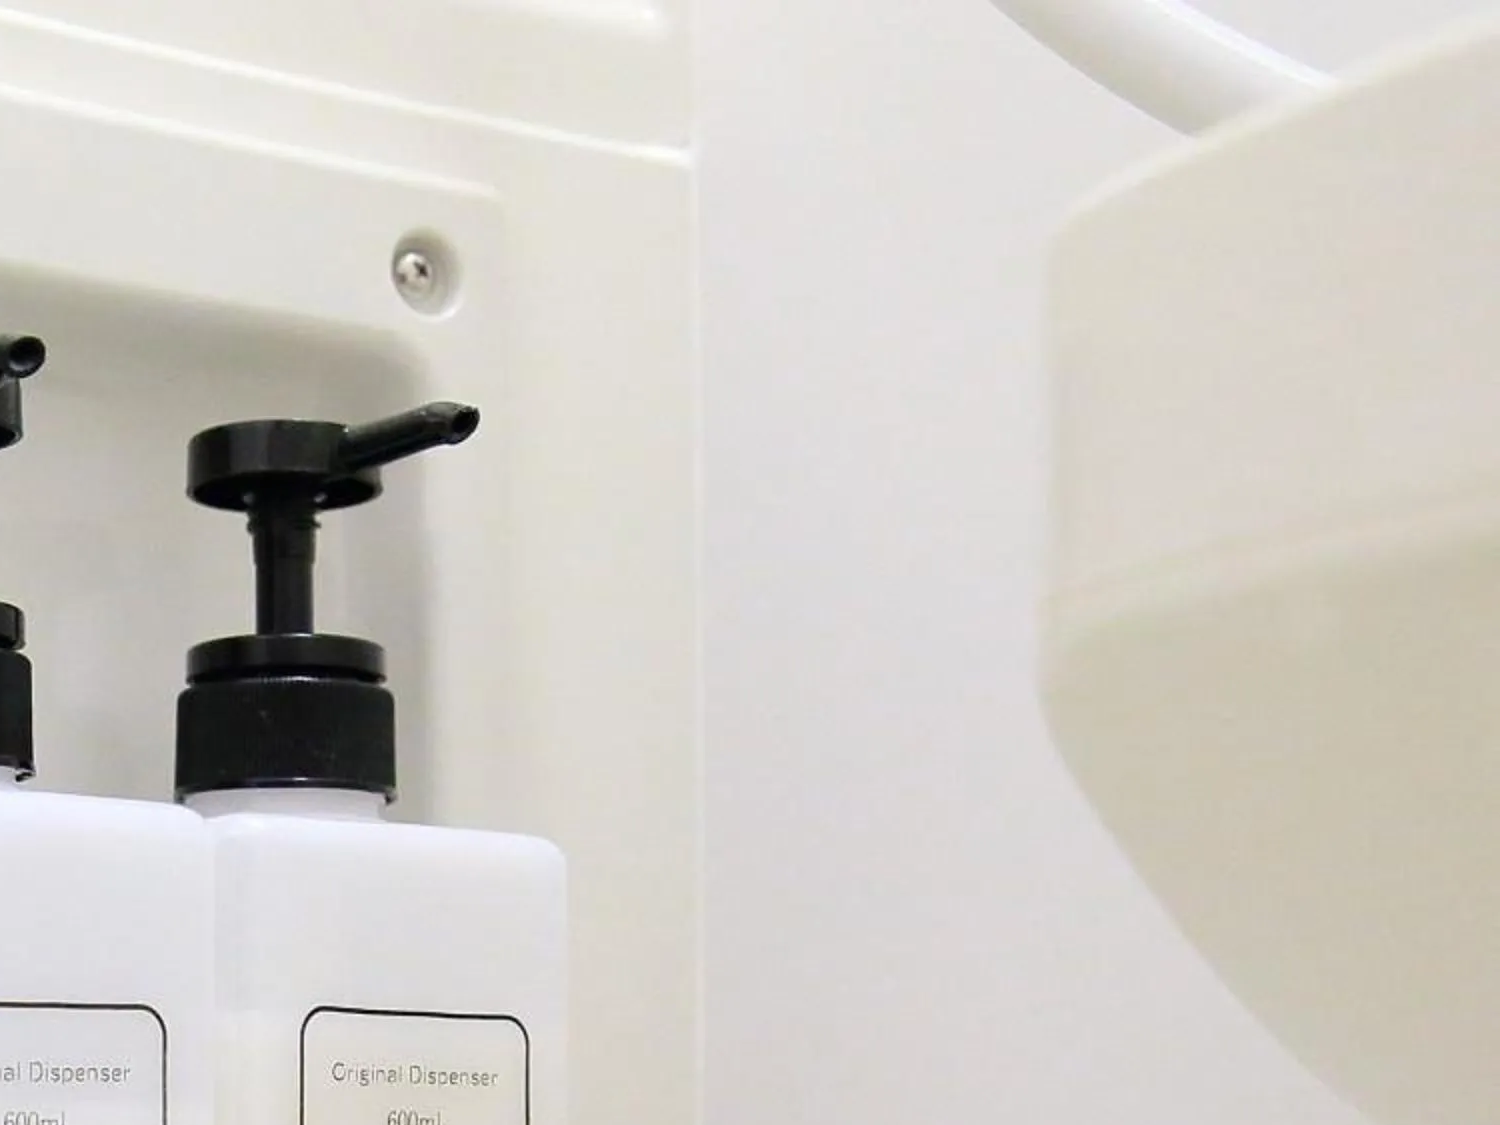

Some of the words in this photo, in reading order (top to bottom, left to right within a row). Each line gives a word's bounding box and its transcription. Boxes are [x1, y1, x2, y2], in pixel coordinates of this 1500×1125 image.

[29, 1061, 131, 1084] Dispenser
[332, 1062, 403, 1087] Original
[409, 1065, 498, 1087] Dispenser
